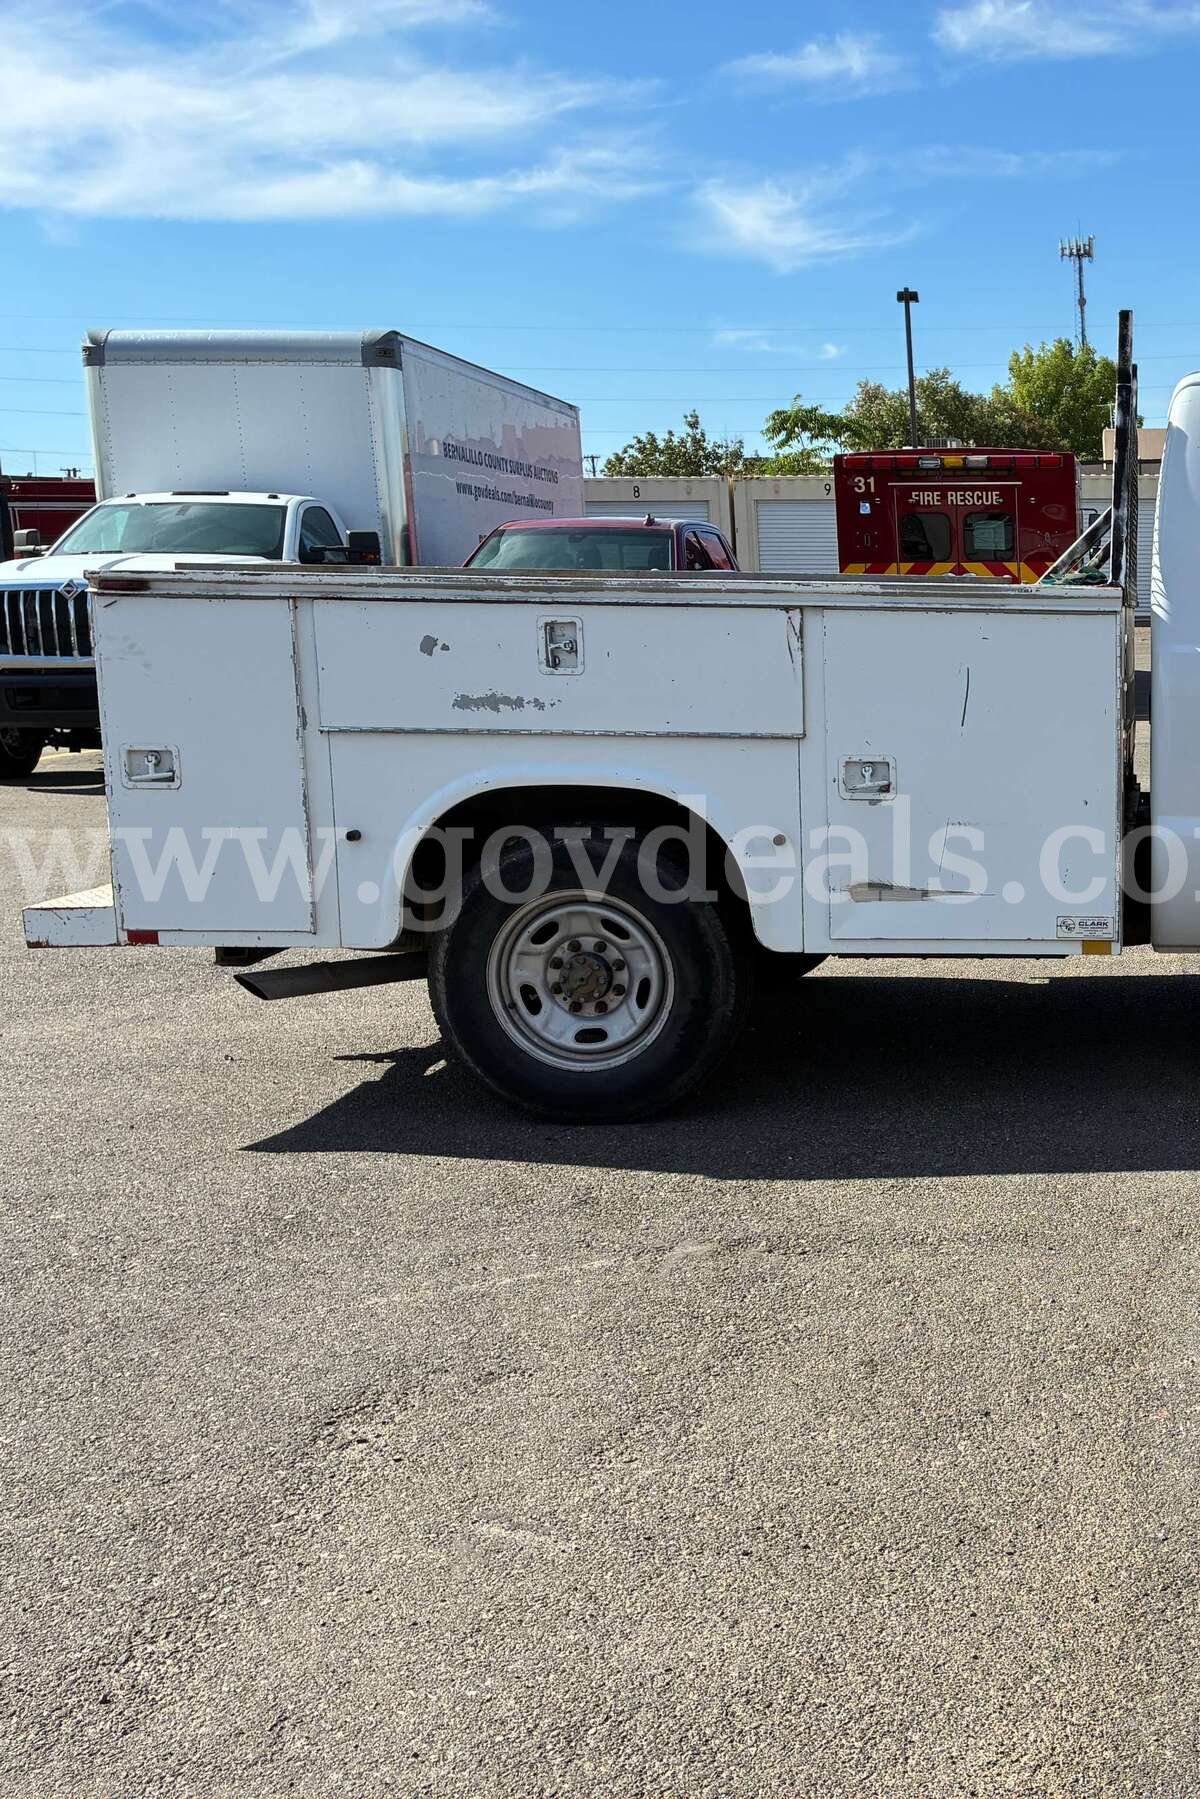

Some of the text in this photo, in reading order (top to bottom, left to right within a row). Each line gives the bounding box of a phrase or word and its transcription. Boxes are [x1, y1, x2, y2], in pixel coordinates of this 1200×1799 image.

[442, 441, 559, 485] BERNALILLO COUNTY SURPLUS AUCTIONS
[633, 486, 641, 499] 8
[824, 483, 832, 496] 9
[853, 476, 876, 494] 31
[910, 491, 1003, 506] FIRE RESCUE
